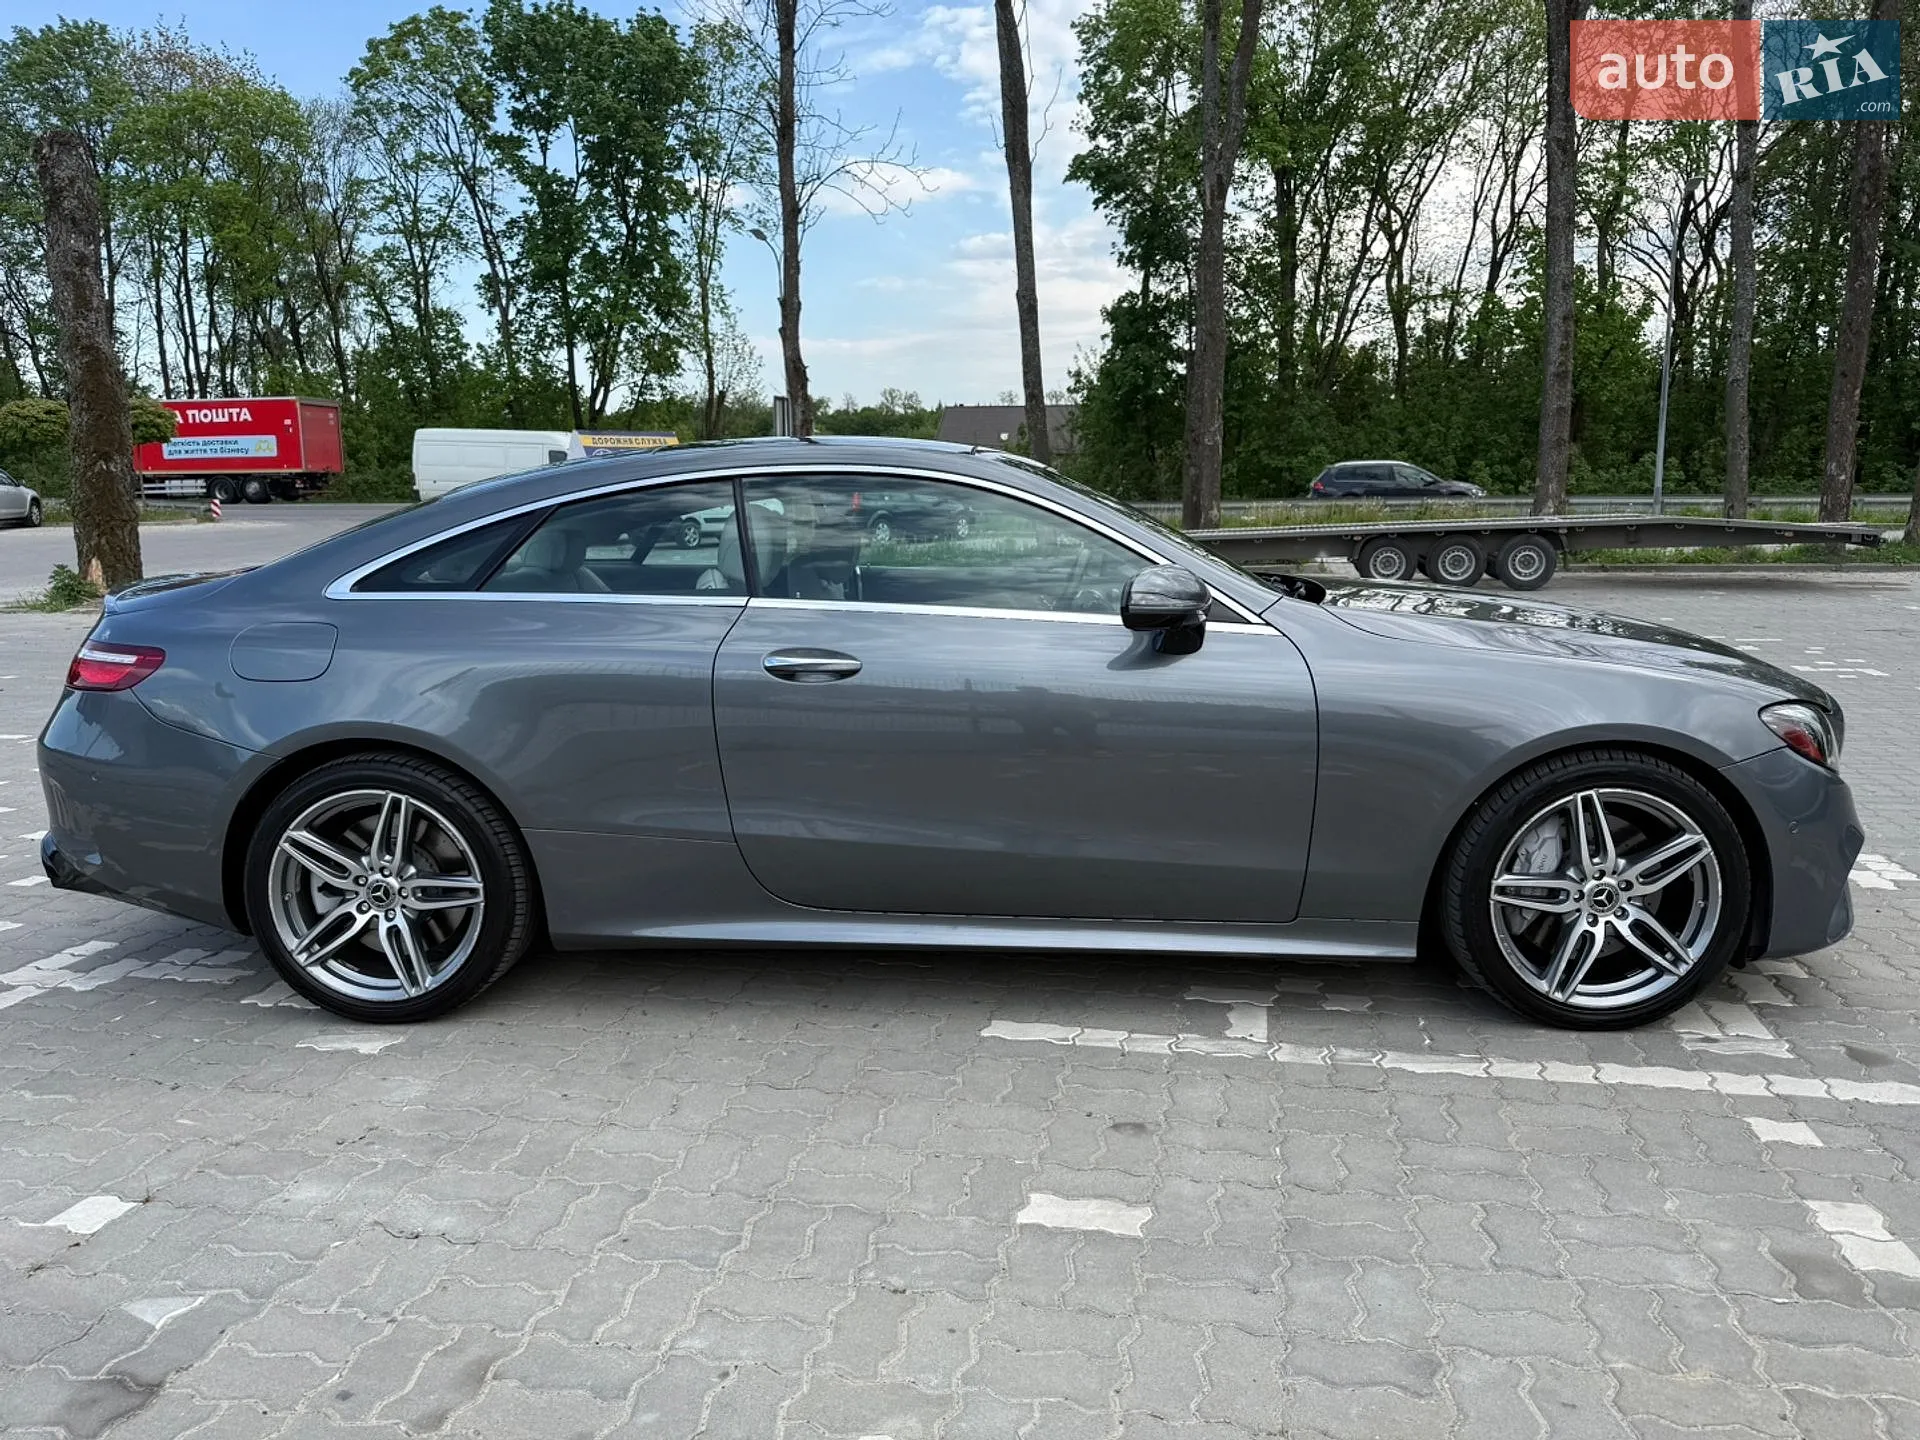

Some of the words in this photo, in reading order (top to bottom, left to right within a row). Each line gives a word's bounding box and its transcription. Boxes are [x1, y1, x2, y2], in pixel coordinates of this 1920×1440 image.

[185, 407, 253, 424] ПОШТА
[201, 439, 239, 447] доставки
[167, 448, 182, 456] для
[219, 446, 249, 455] бізнесу
